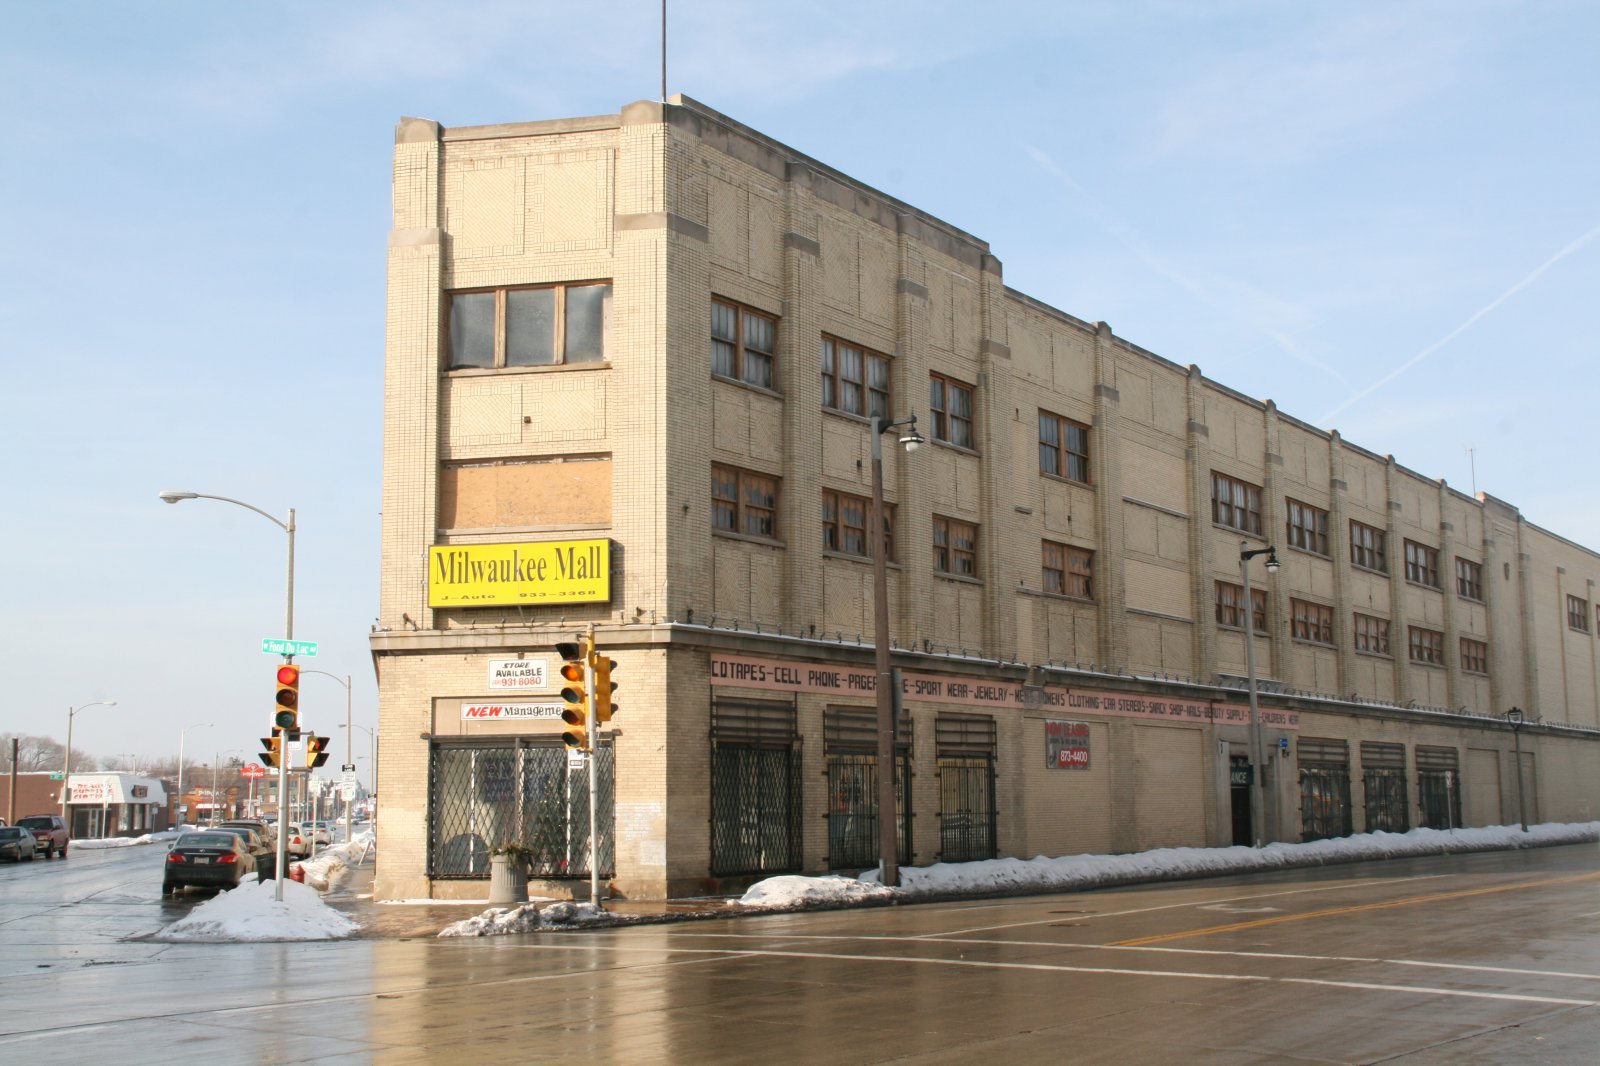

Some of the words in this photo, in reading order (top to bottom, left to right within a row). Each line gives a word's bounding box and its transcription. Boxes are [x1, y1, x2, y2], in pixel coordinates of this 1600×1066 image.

[434, 549, 547, 585] Milwaukee
[553, 545, 602, 580] Mall
[519, 590, 597, 598] 933-3368
[269, 640, 285, 652] Fond
[286, 642, 295, 653] Du
[296, 643, 309, 654] Lac
[502, 661, 531, 669] STORE
[495, 667, 542, 678] AVAILABLE
[465, 706, 503, 718] NEW
[503, 705, 565, 717] Manageme
[1060, 750, 1088, 762] 873-4400
